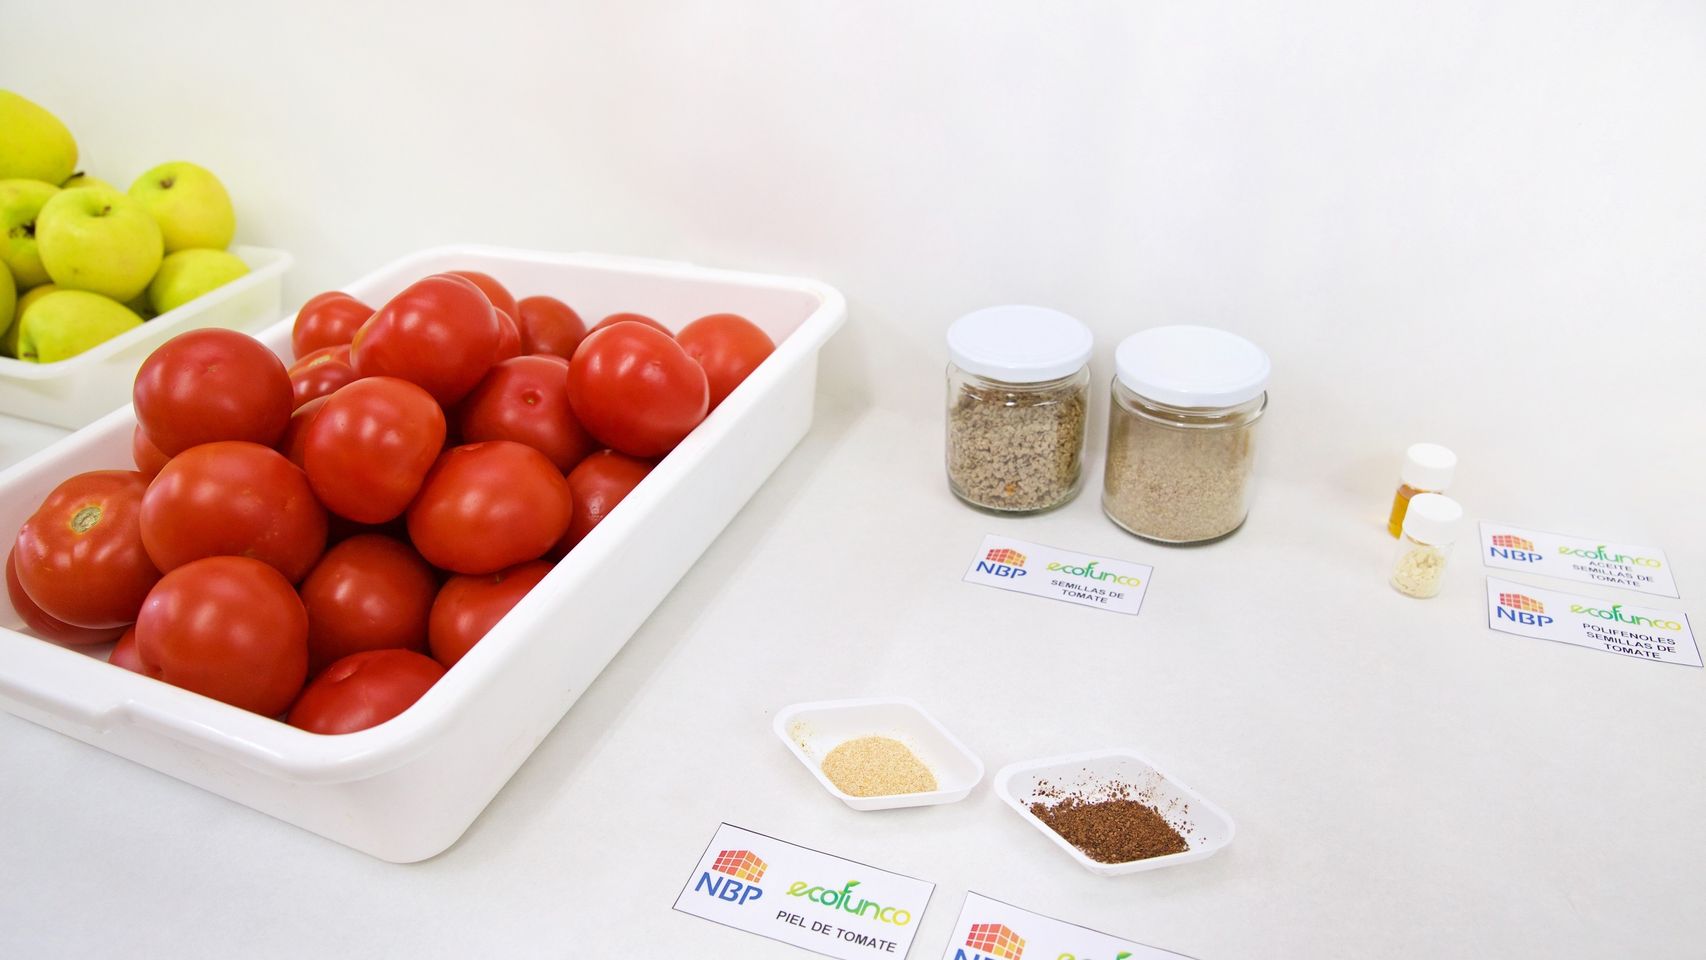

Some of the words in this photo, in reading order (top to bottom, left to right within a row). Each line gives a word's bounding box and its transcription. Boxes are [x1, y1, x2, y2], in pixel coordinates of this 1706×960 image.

[1490, 547, 1543, 563] NBP
[1558, 545, 1661, 568] ecofunco
[976, 561, 1027, 579] NBP
[1046, 560, 1141, 587] ecofunco
[1572, 564, 1634, 579] SEMILLAS
[1637, 575, 1653, 583] DE
[1589, 561, 1633, 572] ACEITE
[1051, 580, 1106, 596] SEMILLAS
[1109, 591, 1125, 599] DE
[1590, 574, 1640, 587] TOMATE
[1062, 589, 1107, 604] TOMATE
[1497, 606, 1554, 627] NBP
[1570, 604, 1682, 631] ecofunco
[1583, 623, 1676, 645] POLIFENOLES
[1587, 632, 1653, 649] SEMILLAS
[1657, 645, 1676, 653] DE
[1604, 644, 1661, 659] TOMATE
[694, 871, 763, 905] NBP
[786, 880, 911, 926] ecofunco
[776, 911, 806, 928] PIEL
[811, 921, 833, 935] DE
[837, 928, 897, 953] TOMATE
